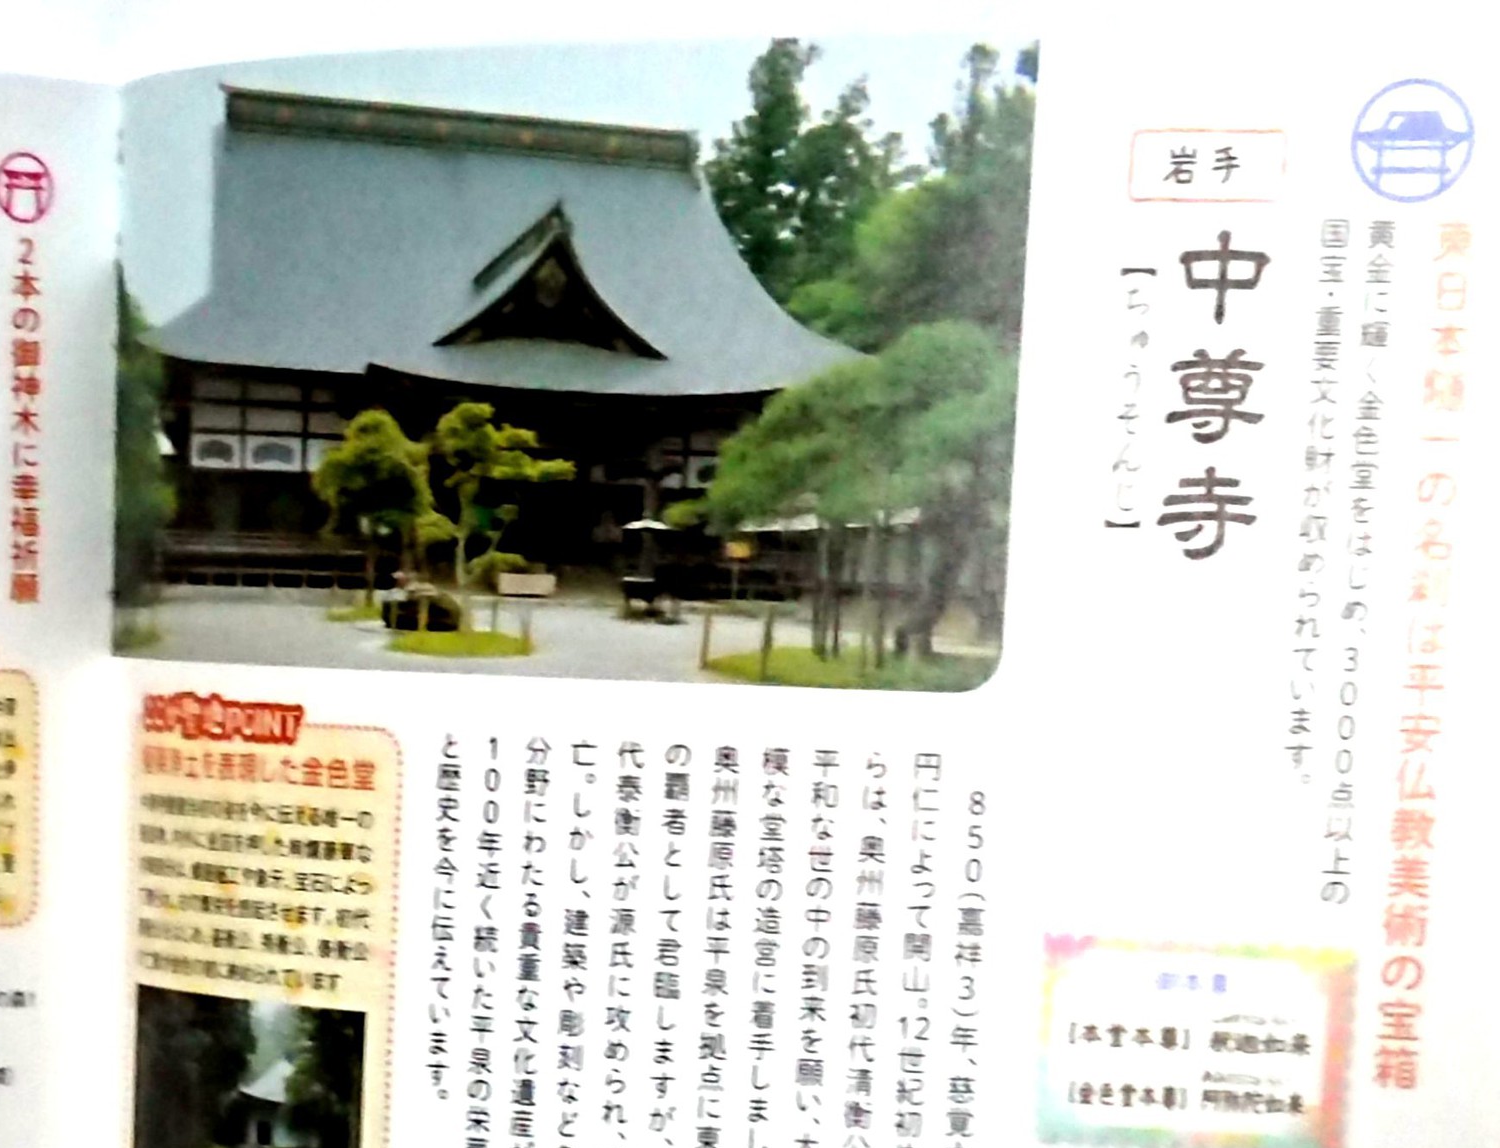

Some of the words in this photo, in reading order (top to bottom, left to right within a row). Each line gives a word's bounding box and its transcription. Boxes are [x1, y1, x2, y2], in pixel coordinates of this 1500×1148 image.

[1163, 145, 1241, 185] 岩手
[1156, 229, 1271, 561] 中尊寺
